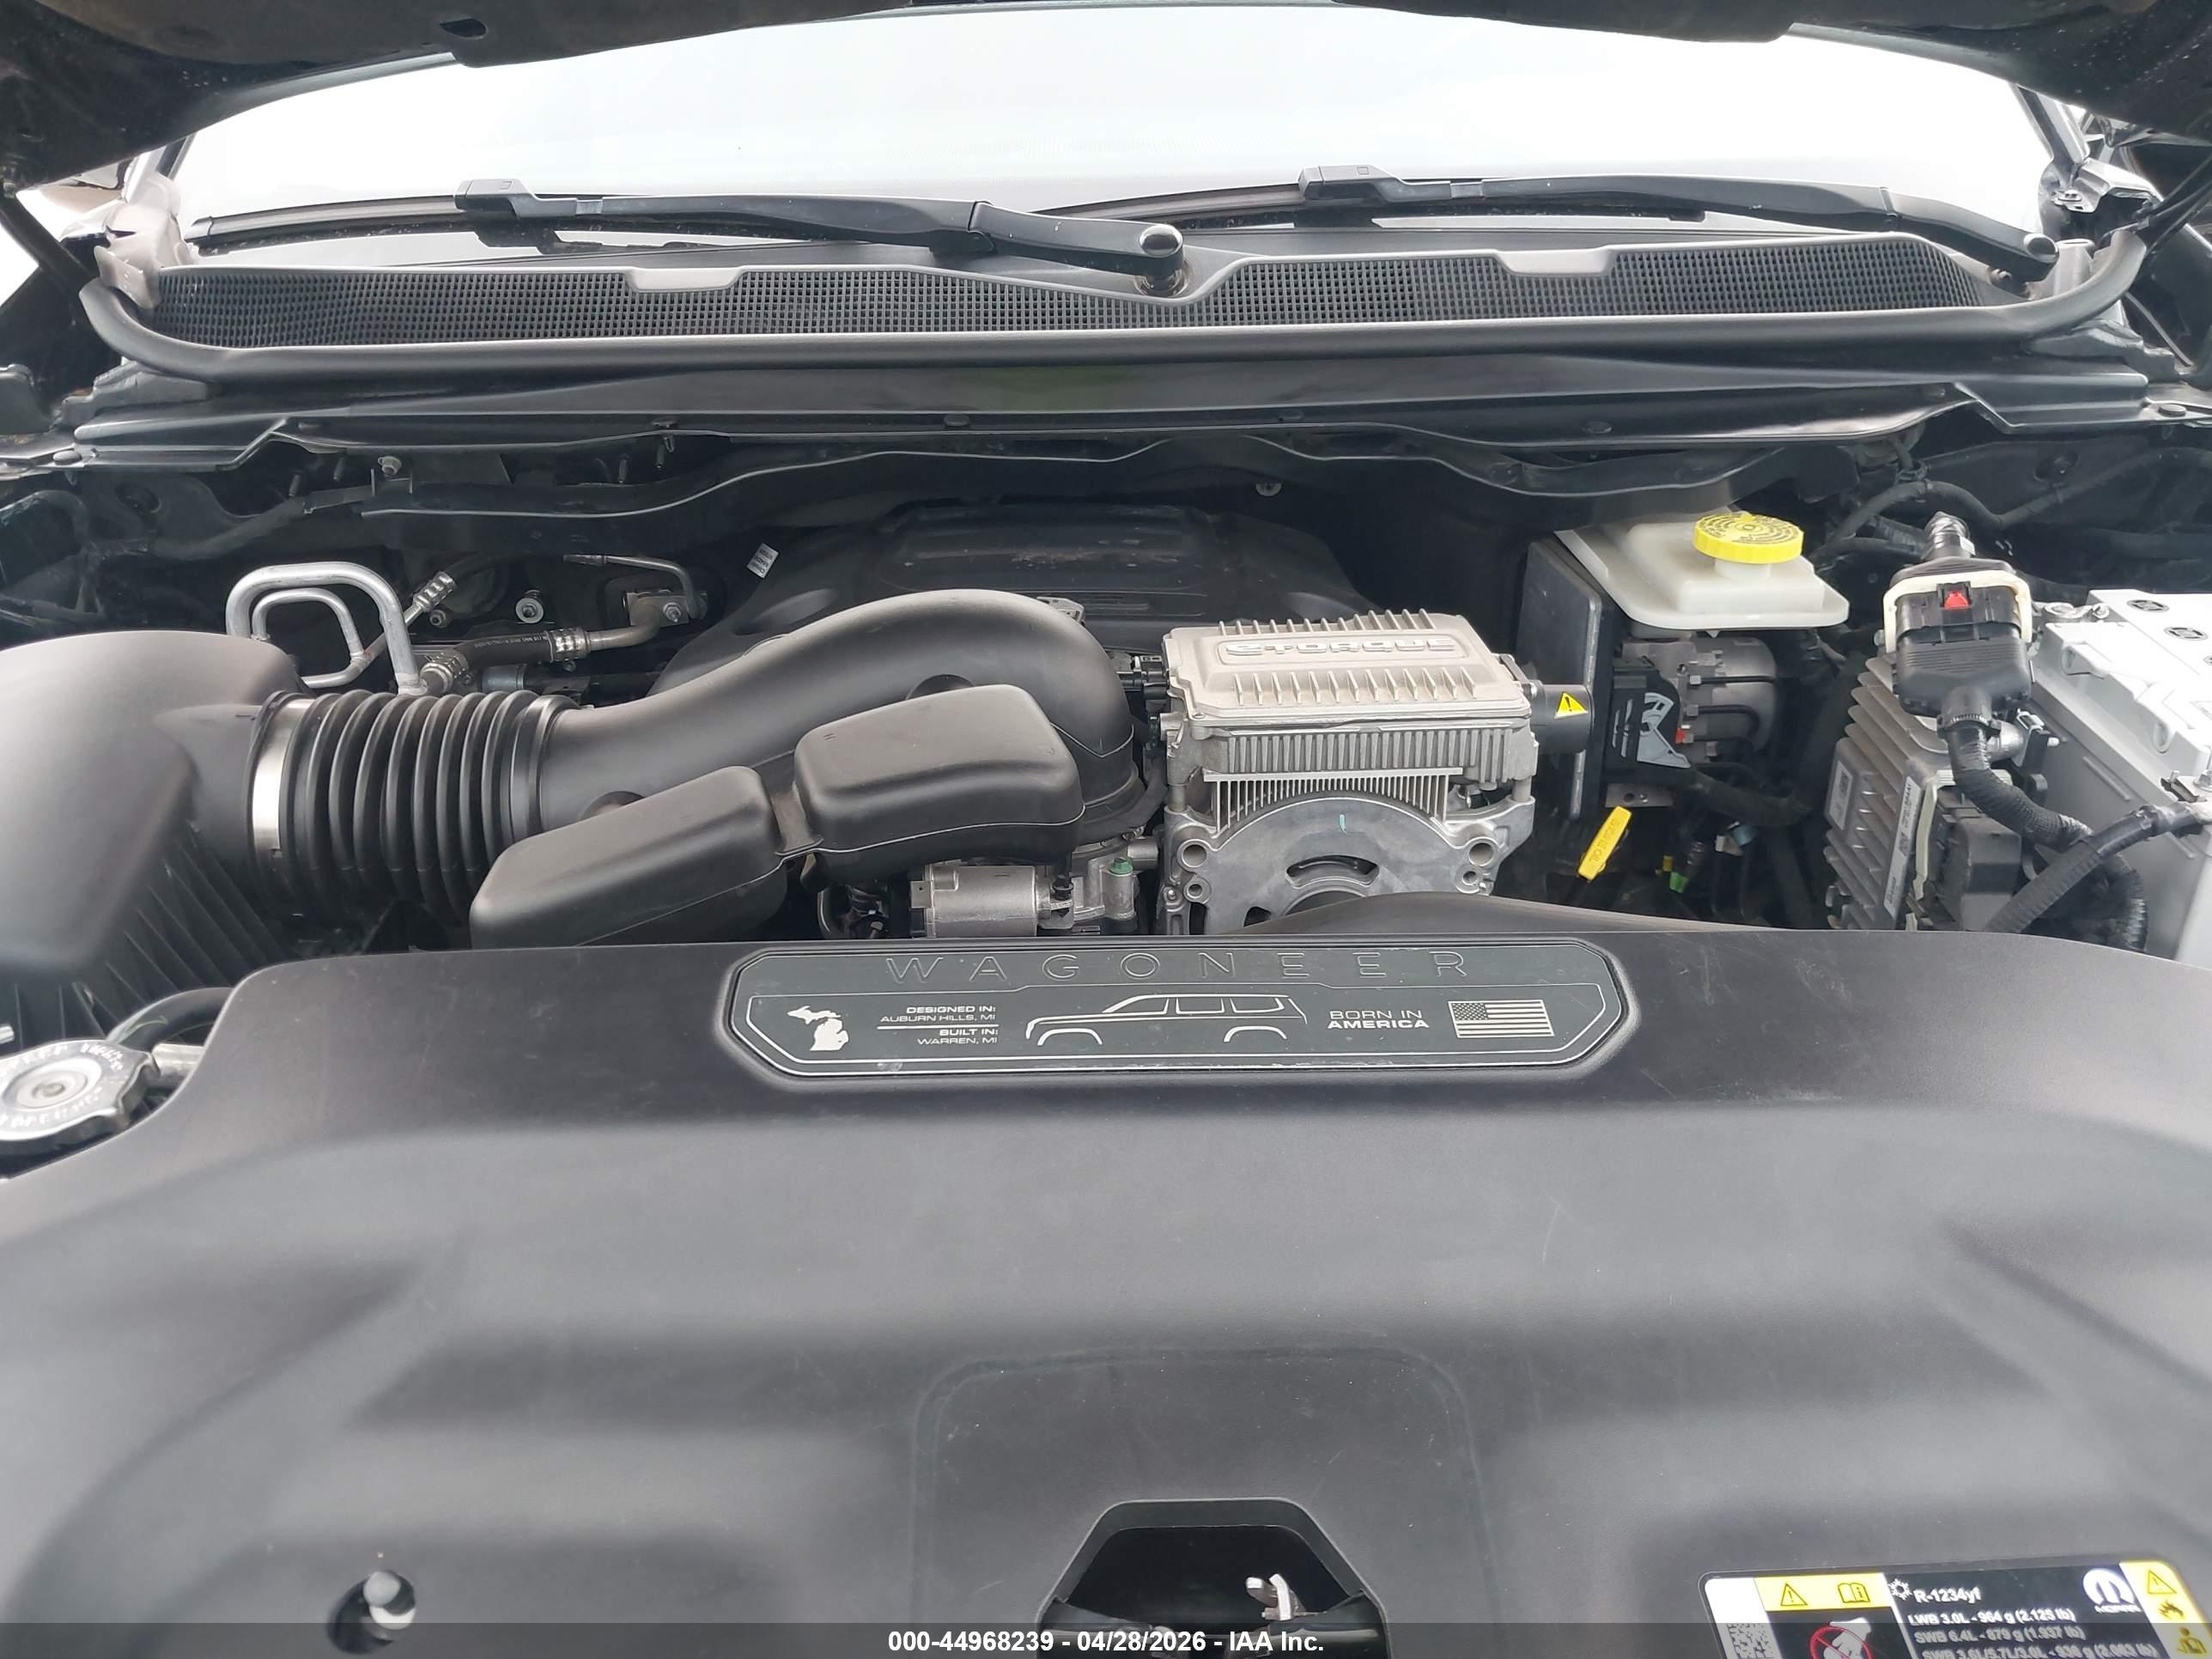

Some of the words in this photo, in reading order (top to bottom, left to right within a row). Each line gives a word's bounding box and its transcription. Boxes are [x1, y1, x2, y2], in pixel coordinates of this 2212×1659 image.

[886, 951, 1467, 983] WAGONEER
[906, 1006, 975, 1014] DESIGNED
[1329, 1010, 1392, 1020] BORN
[1401, 1010, 1423, 1019] IN
[1328, 1019, 1430, 1029] AMERICA
[1913, 1587, 1982, 1604] R-1234yf
[1907, 1613, 1940, 1626] LWB
[1940, 1613, 1971, 1625] 3.0L
[1978, 1610, 2003, 1624] 964
[2003, 1612, 2016, 1625] g
[2014, 1607, 2056, 1624] (2.125
[2054, 1607, 2076, 1623] lb)
[1914, 1630, 1948, 1644] SWB
[1948, 1629, 1978, 1642] 6.4L
[1985, 1627, 2012, 1641] 879
[2012, 1630, 2025, 1643] g
[2024, 1626, 2063, 1642] (1.937
[2063, 1626, 2087, 1640] lb)
[1922, 1649, 1957, 1659] SWB
